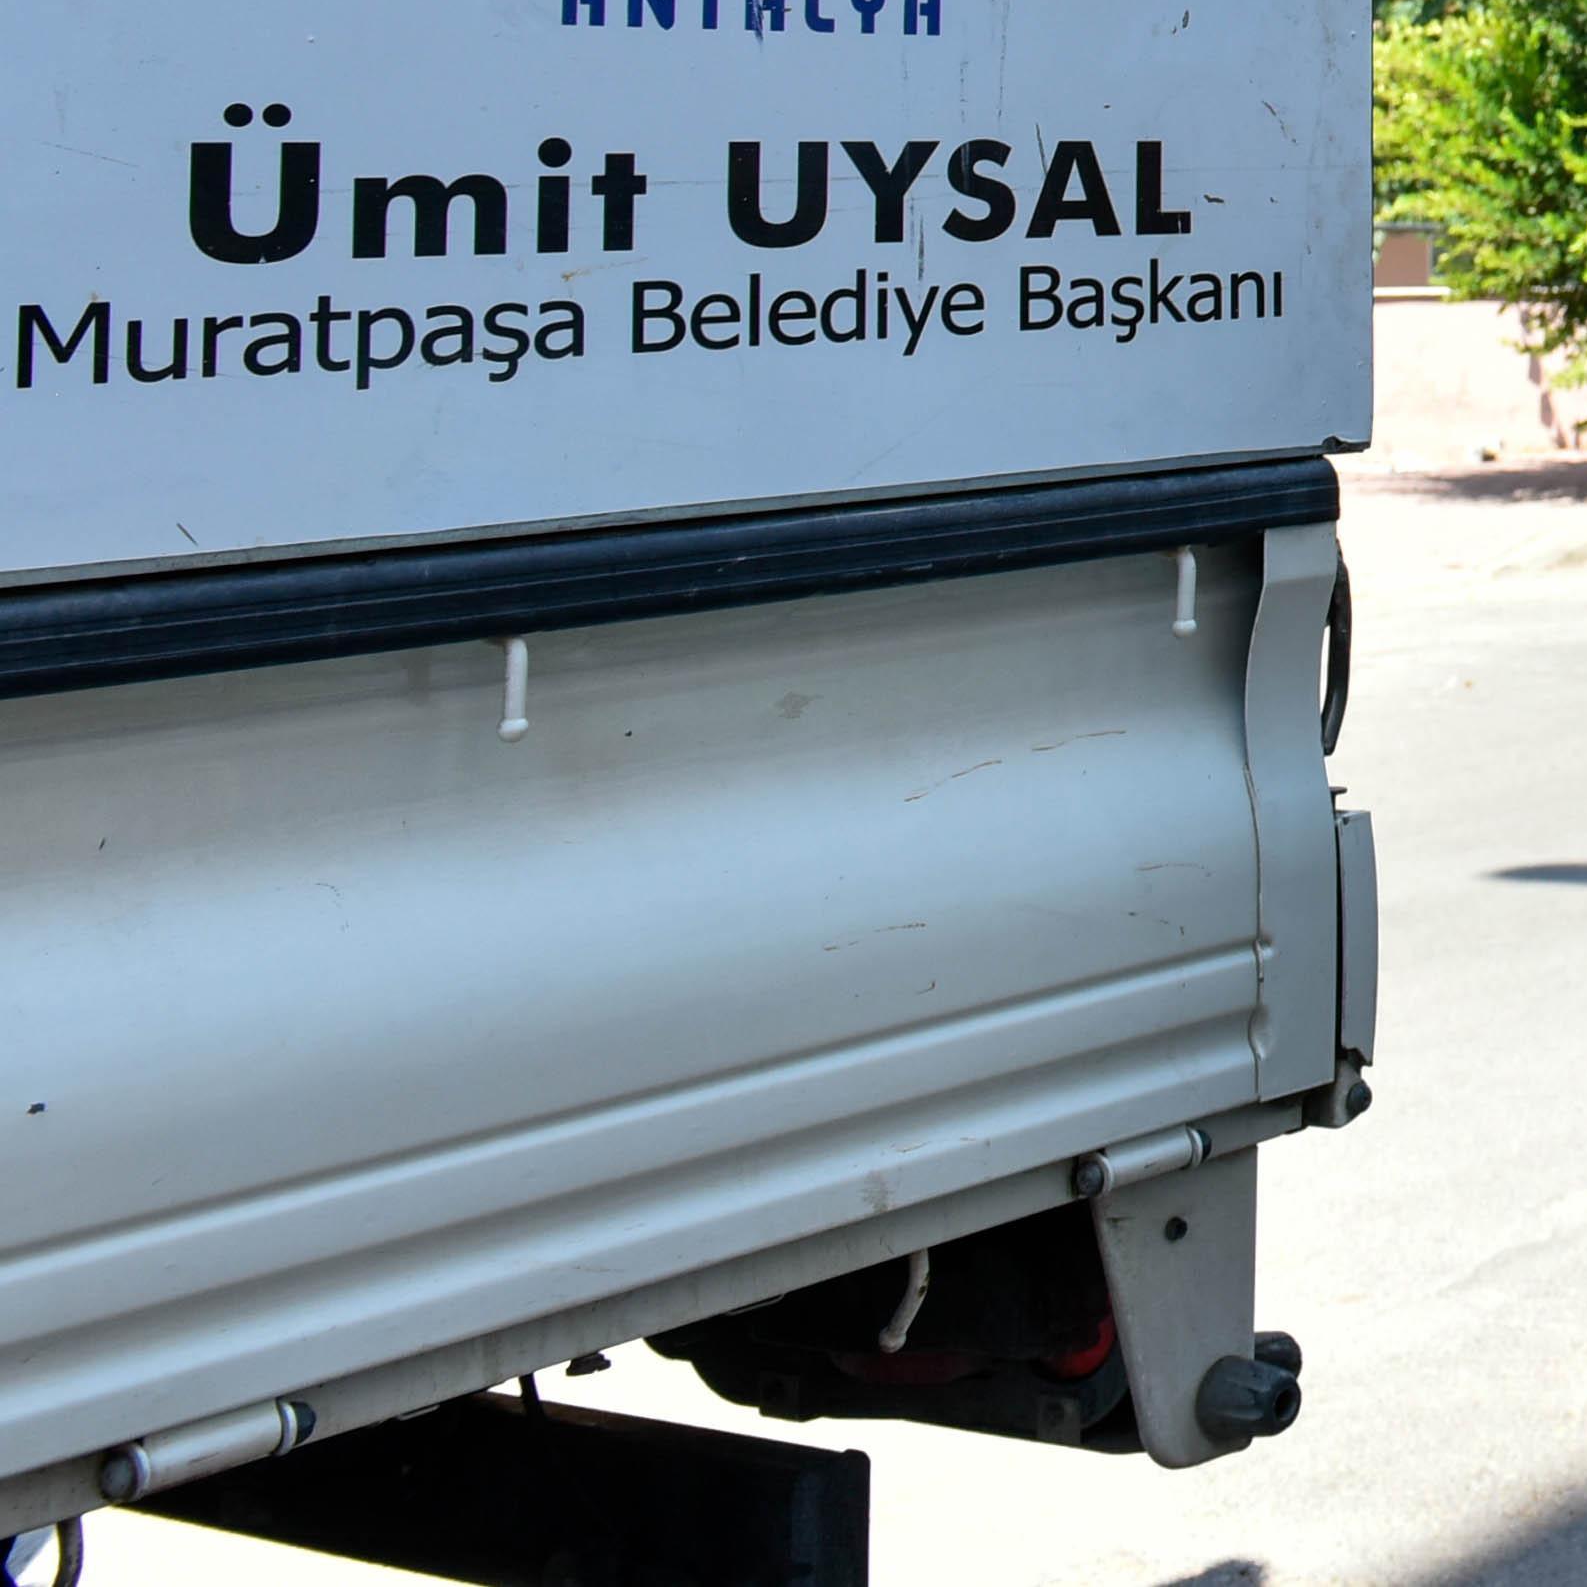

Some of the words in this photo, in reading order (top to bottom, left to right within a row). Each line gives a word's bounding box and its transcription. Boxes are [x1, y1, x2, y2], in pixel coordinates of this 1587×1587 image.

[188, 103, 648, 266] Ümit
[727, 139, 1192, 249] UYSAL
[16, 295, 587, 391] Muratpaşa
[630, 270, 985, 357] Belediye
[1017, 257, 1283, 345] Başkanı
